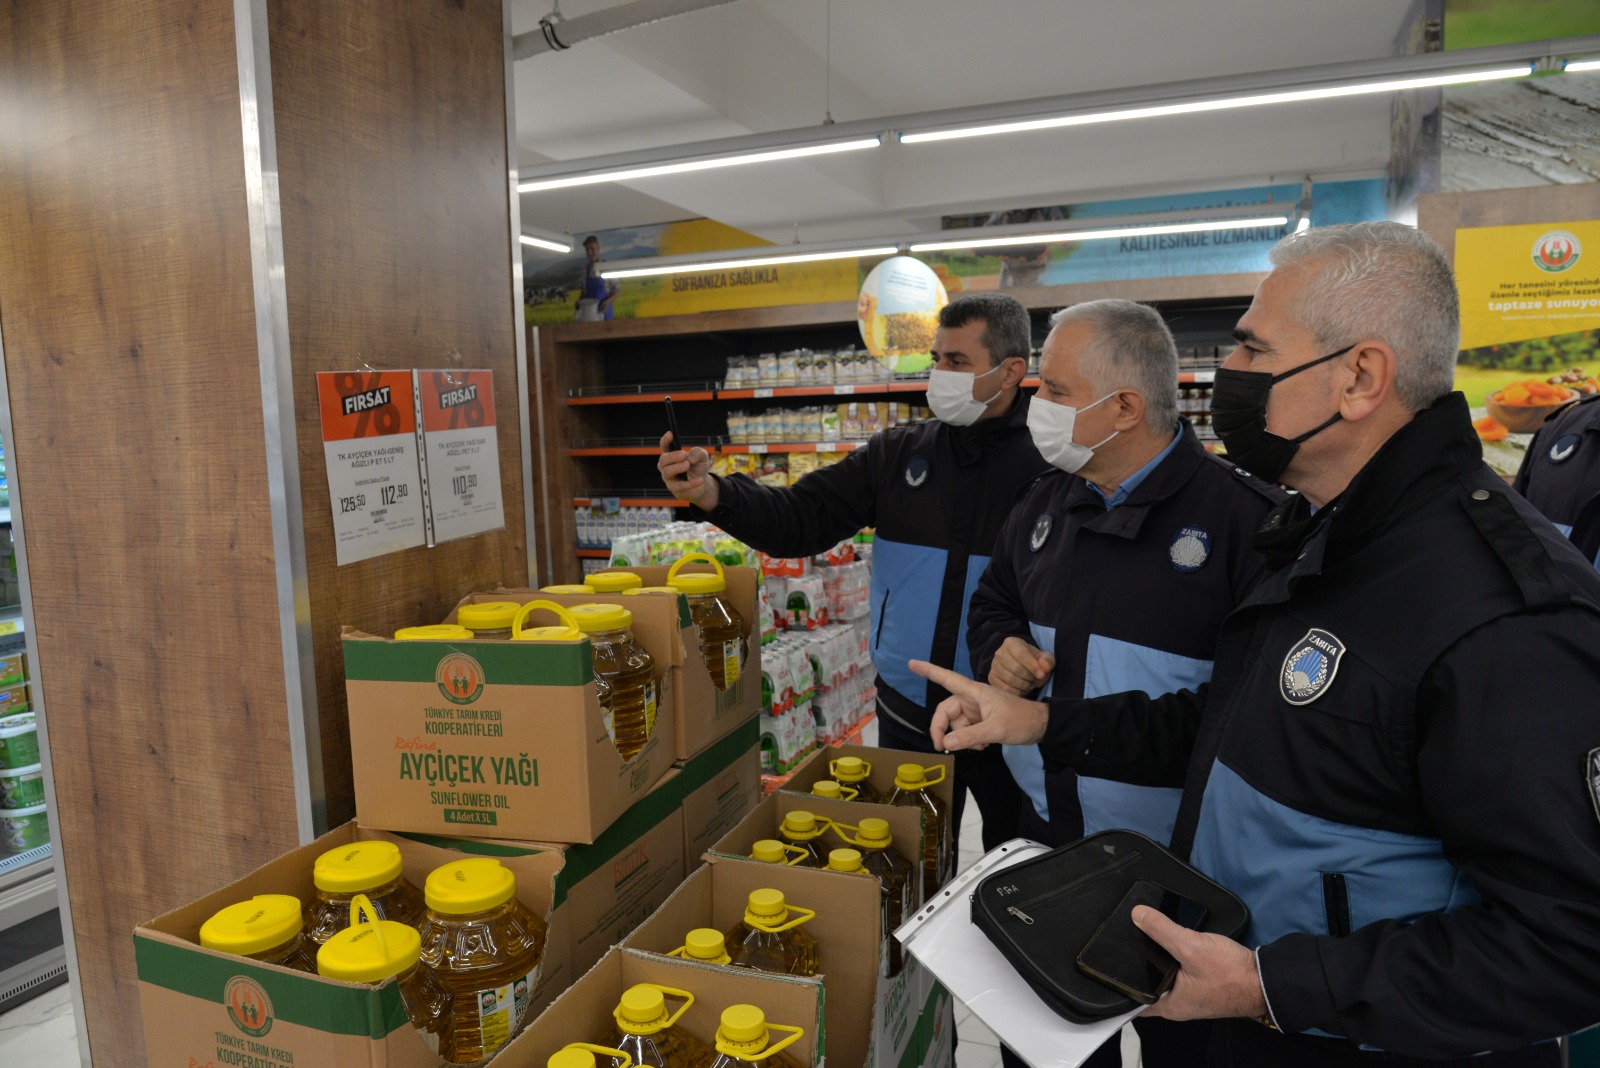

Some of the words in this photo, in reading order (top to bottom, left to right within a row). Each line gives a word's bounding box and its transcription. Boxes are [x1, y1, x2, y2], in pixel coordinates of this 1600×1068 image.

[672, 273, 727, 293] SOFRANIZA
[729, 268, 779, 287] SAĞLIKLA
[1519, 280, 1556, 289] tanesini
[1490, 291, 1520, 299] özenle
[1523, 288, 1570, 298] seçtiğimiz
[1488, 300, 1542, 313] taptaze
[345, 386, 390, 414] FIRSAT
[441, 385, 477, 408] FIRSAT
[338, 453, 346, 461] TK
[347, 449, 373, 460] AYÇİÇEK
[351, 459, 370, 469] AĞIZLI
[341, 494, 366, 513] 125,50
[381, 484, 408, 506] 112,90
[1181, 528, 1208, 539] ZABITA
[1308, 633, 1338, 656] ZABITA
[424, 706, 455, 720] TÜRKİYE
[456, 708, 479, 720] TARIM
[480, 708, 502, 721] KREDİ
[425, 720, 503, 737] KOOPERATİFLERİ
[394, 736, 437, 753] Rafine
[400, 749, 486, 788] AYÇİÇEK
[490, 752, 539, 787] YAĞI
[430, 791, 492, 808] SUNFLOWER
[494, 794, 510, 809] OIL
[450, 810, 455, 820] 4
[456, 810, 475, 822] Adet
[475, 811, 481, 822] X
[482, 812, 491, 823] 5L
[215, 1031, 245, 1050] TÜRKİYE
[246, 1040, 269, 1057] TARIM
[270, 1047, 294, 1064] KREDİ
